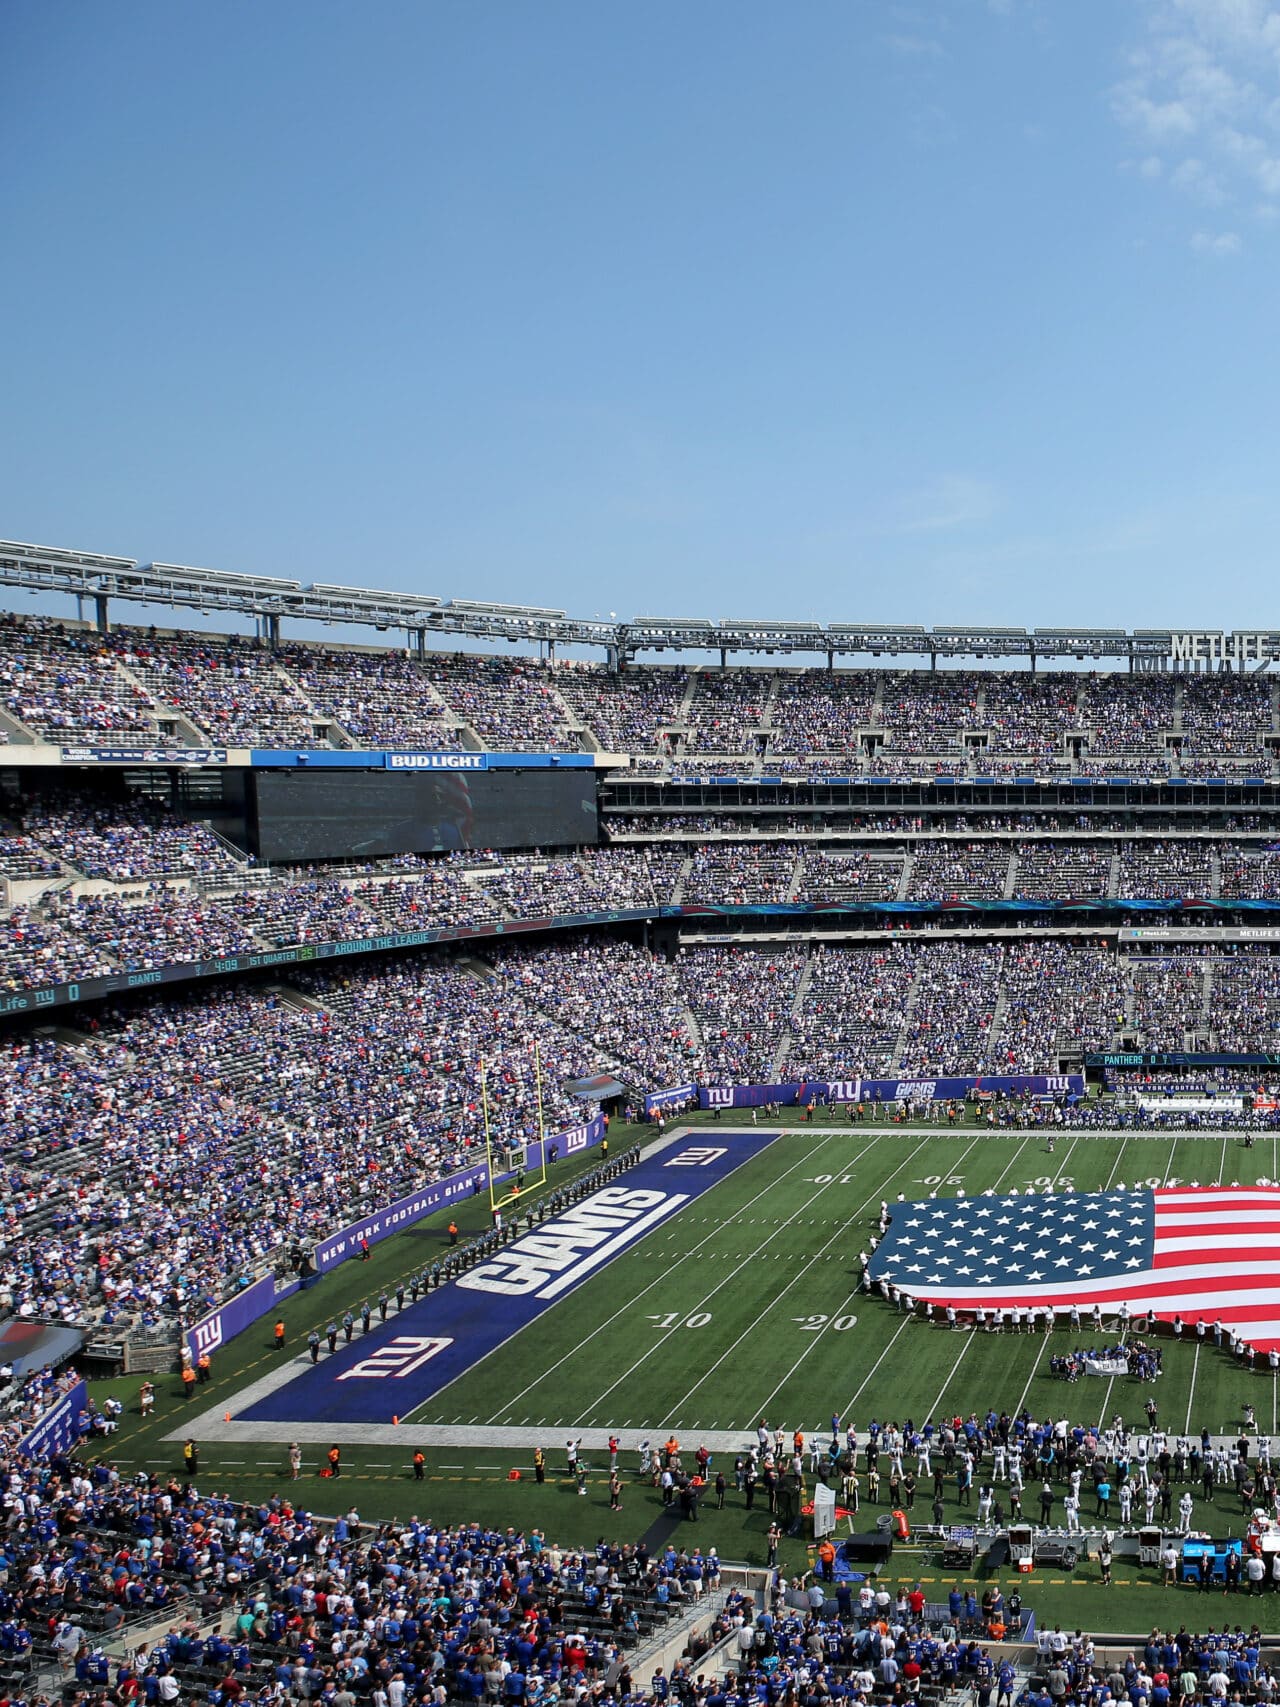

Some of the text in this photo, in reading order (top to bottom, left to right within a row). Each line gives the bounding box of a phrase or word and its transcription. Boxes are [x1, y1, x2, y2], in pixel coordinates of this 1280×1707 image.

[1171, 634, 1272, 661] METLIFE
[391, 755, 483, 769] BUD LIGHT
[1240, 930, 1273, 938] METLIFE
[334, 932, 429, 955] AROUND THE LEAGUE
[262, 950, 296, 965] QUARTER
[300, 948, 313, 960] 25
[214, 959, 238, 972] 4:09
[127, 971, 162, 986] GIANTS
[34, 989, 55, 1007] ny
[68, 984, 79, 1001] 0
[1104, 1055, 1156, 1065] PANTHERS 0
[827, 1080, 861, 1102] ny
[895, 1081, 937, 1098] GIANTS
[1046, 1077, 1070, 1095] ny
[707, 1088, 734, 1108] ny
[567, 1127, 587, 1154] ny
[512, 1152, 523, 1163] 25
[662, 1147, 729, 1167] ny
[322, 1240, 346, 1263] NEW
[349, 1222, 380, 1246] YORK
[385, 1194, 441, 1228] FOOTBALL
[454, 1185, 676, 1296] GIANTS
[652, 1312, 713, 1329] 10
[799, 1314, 858, 1331] 20
[195, 1315, 224, 1358] ny
[336, 1336, 455, 1382] ny
[28, 1427, 47, 1450] WORLD
[45, 1399, 74, 1431] CHAMPIONS
